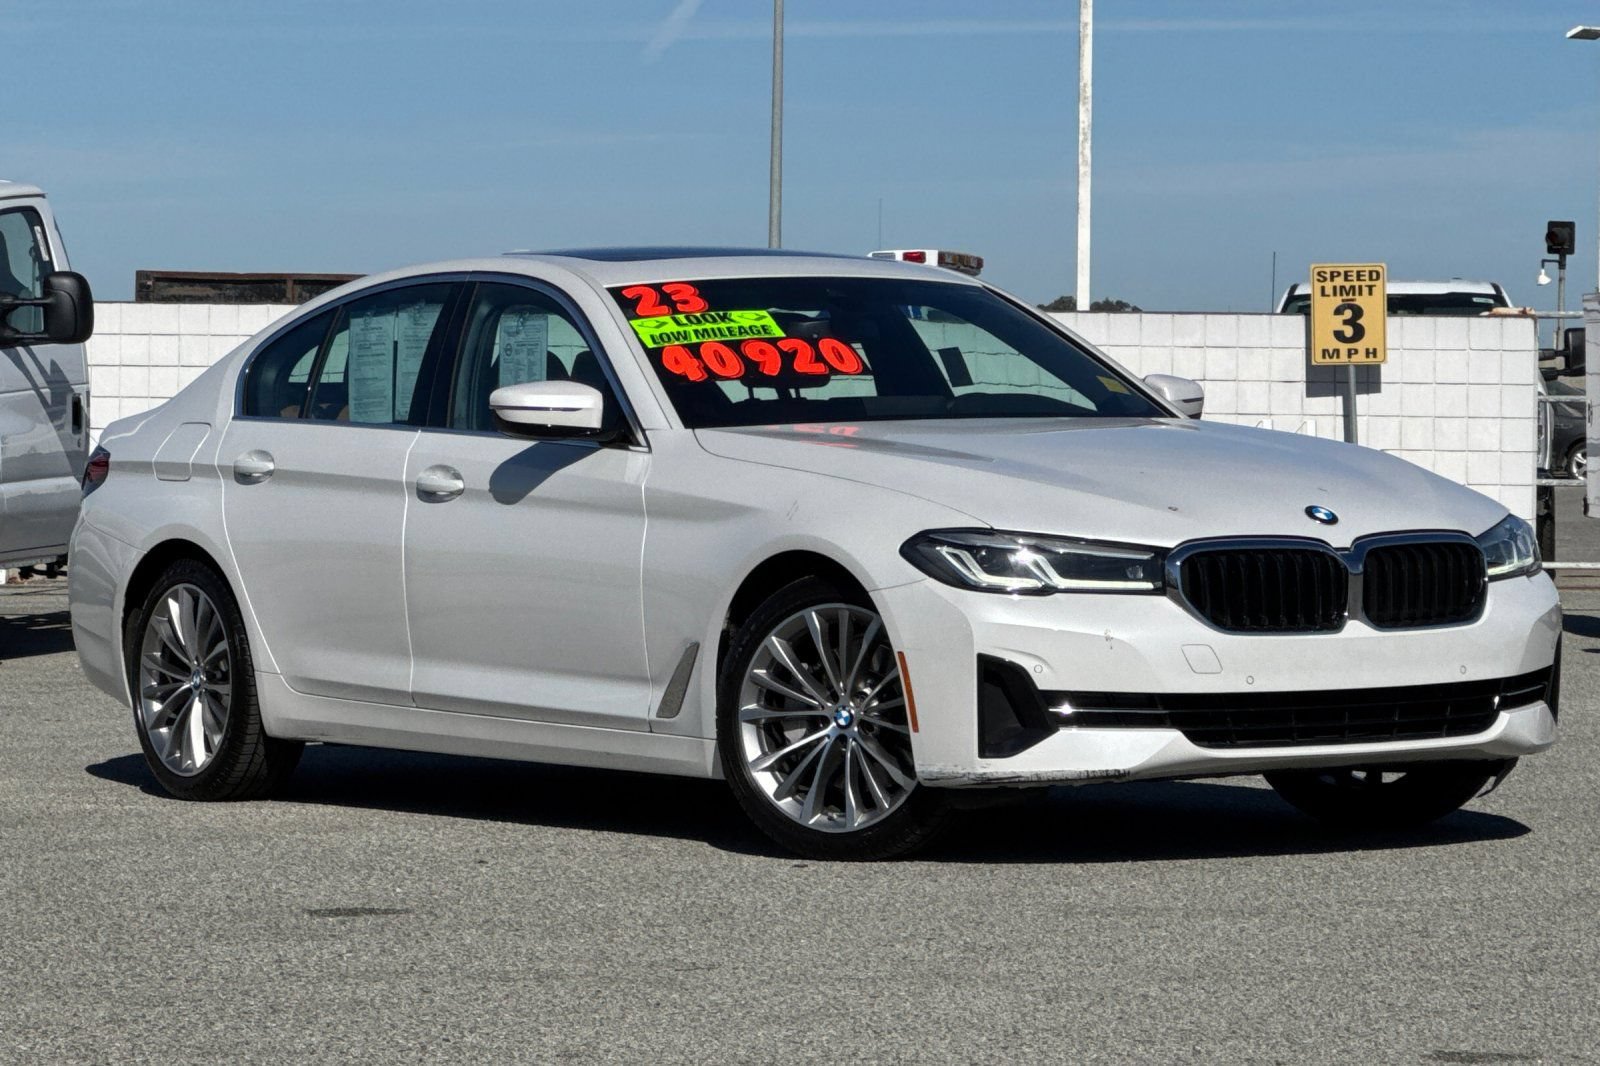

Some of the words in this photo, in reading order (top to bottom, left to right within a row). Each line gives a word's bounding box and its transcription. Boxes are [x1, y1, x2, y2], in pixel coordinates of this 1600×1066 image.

[1316, 270, 1381, 282] SPEED
[622, 283, 708, 317] 23
[1320, 285, 1376, 297] LIMIT
[670, 312, 735, 327] LOOK
[1333, 303, 1366, 344] 3
[650, 330, 691, 345] LOW
[694, 324, 773, 341] MILEAGE
[662, 338, 862, 381] 40920
